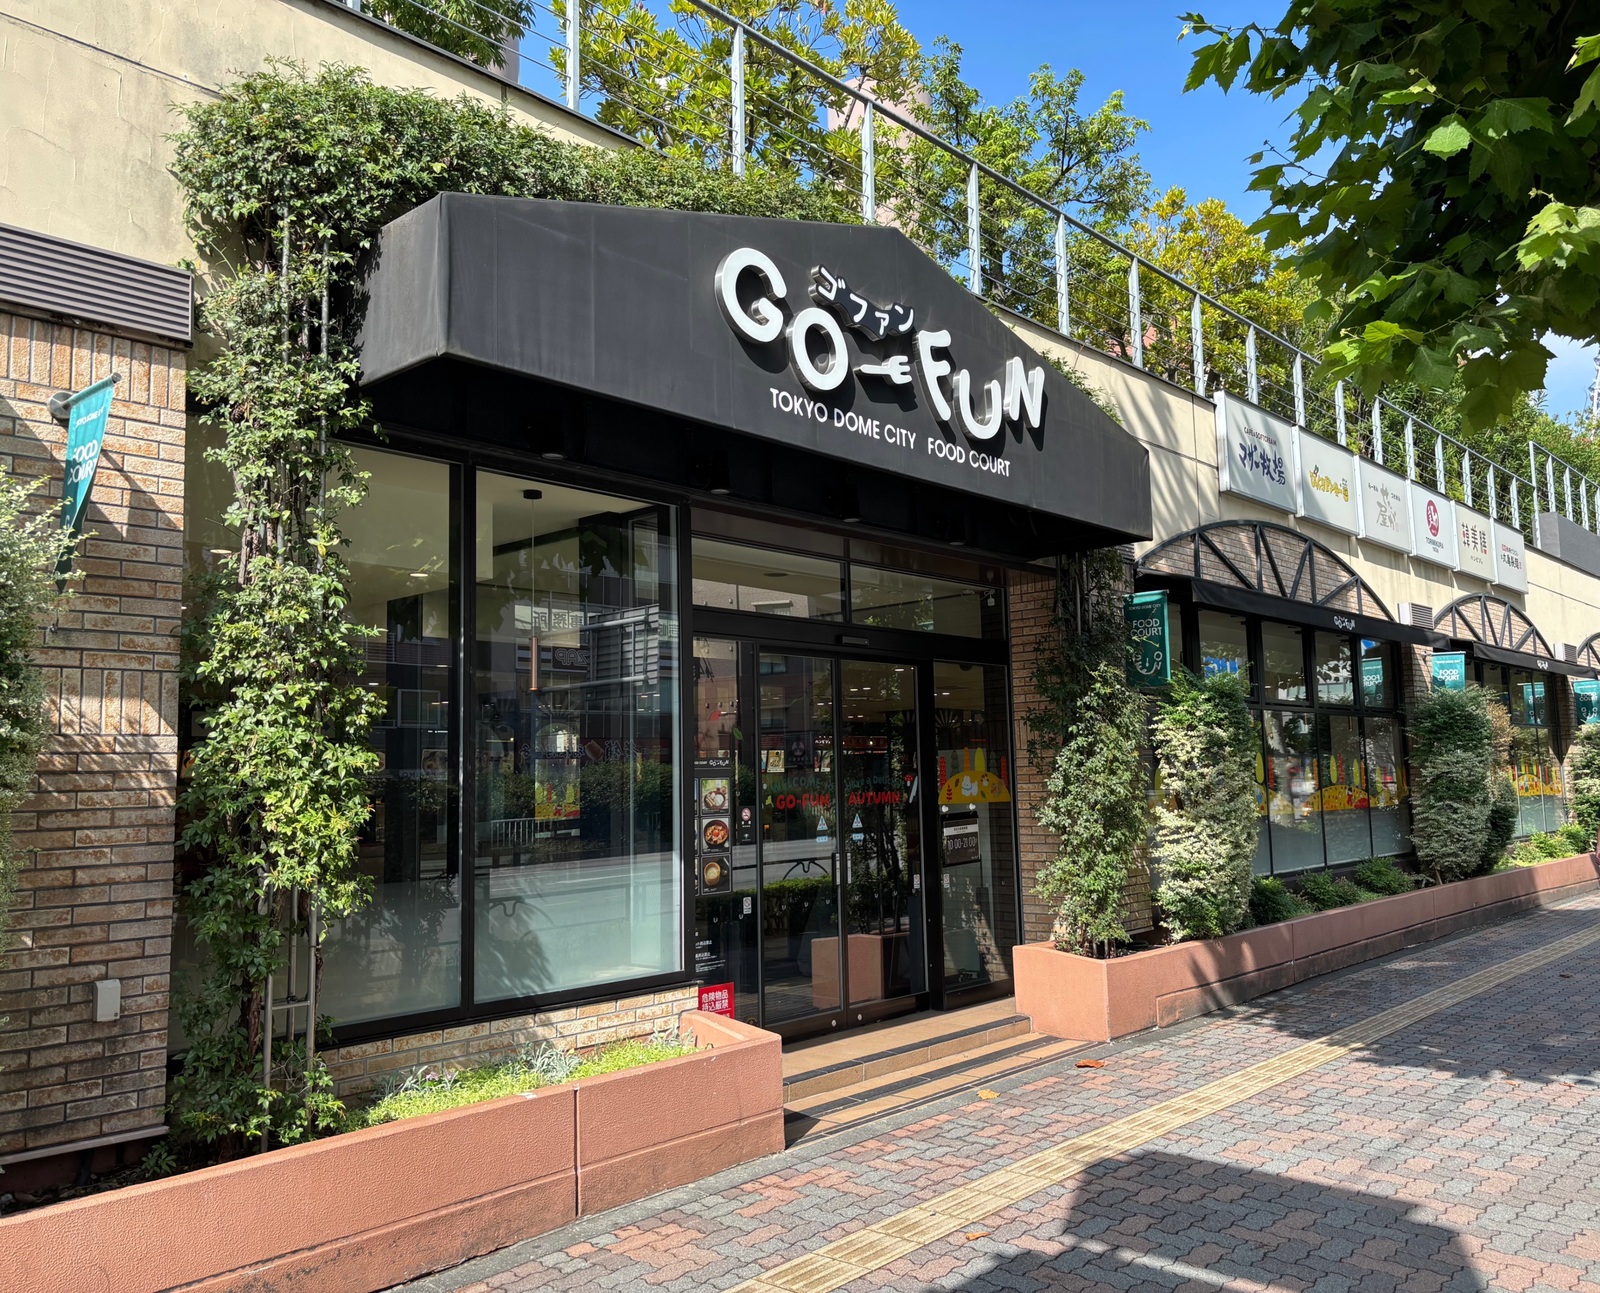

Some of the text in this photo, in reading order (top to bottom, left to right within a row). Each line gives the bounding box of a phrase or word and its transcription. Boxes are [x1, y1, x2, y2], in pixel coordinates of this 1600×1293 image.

[811, 264, 915, 336] ゴファン
[769, 387, 1011, 477] TOKYO DOME CITY FOOD COURT
[1238, 442, 1286, 486] マザー牧場
[1132, 618, 1160, 629] FOOD
[1130, 627, 1163, 638] COURT
[1437, 674, 1460, 682] COURT
[769, 776, 821, 793] WELCOME
[775, 793, 830, 810] GO-FUN
[848, 791, 901, 806] AUTUMN
[701, 989, 729, 1003] 危険物品
[701, 999, 729, 1012] 持込厳禁
